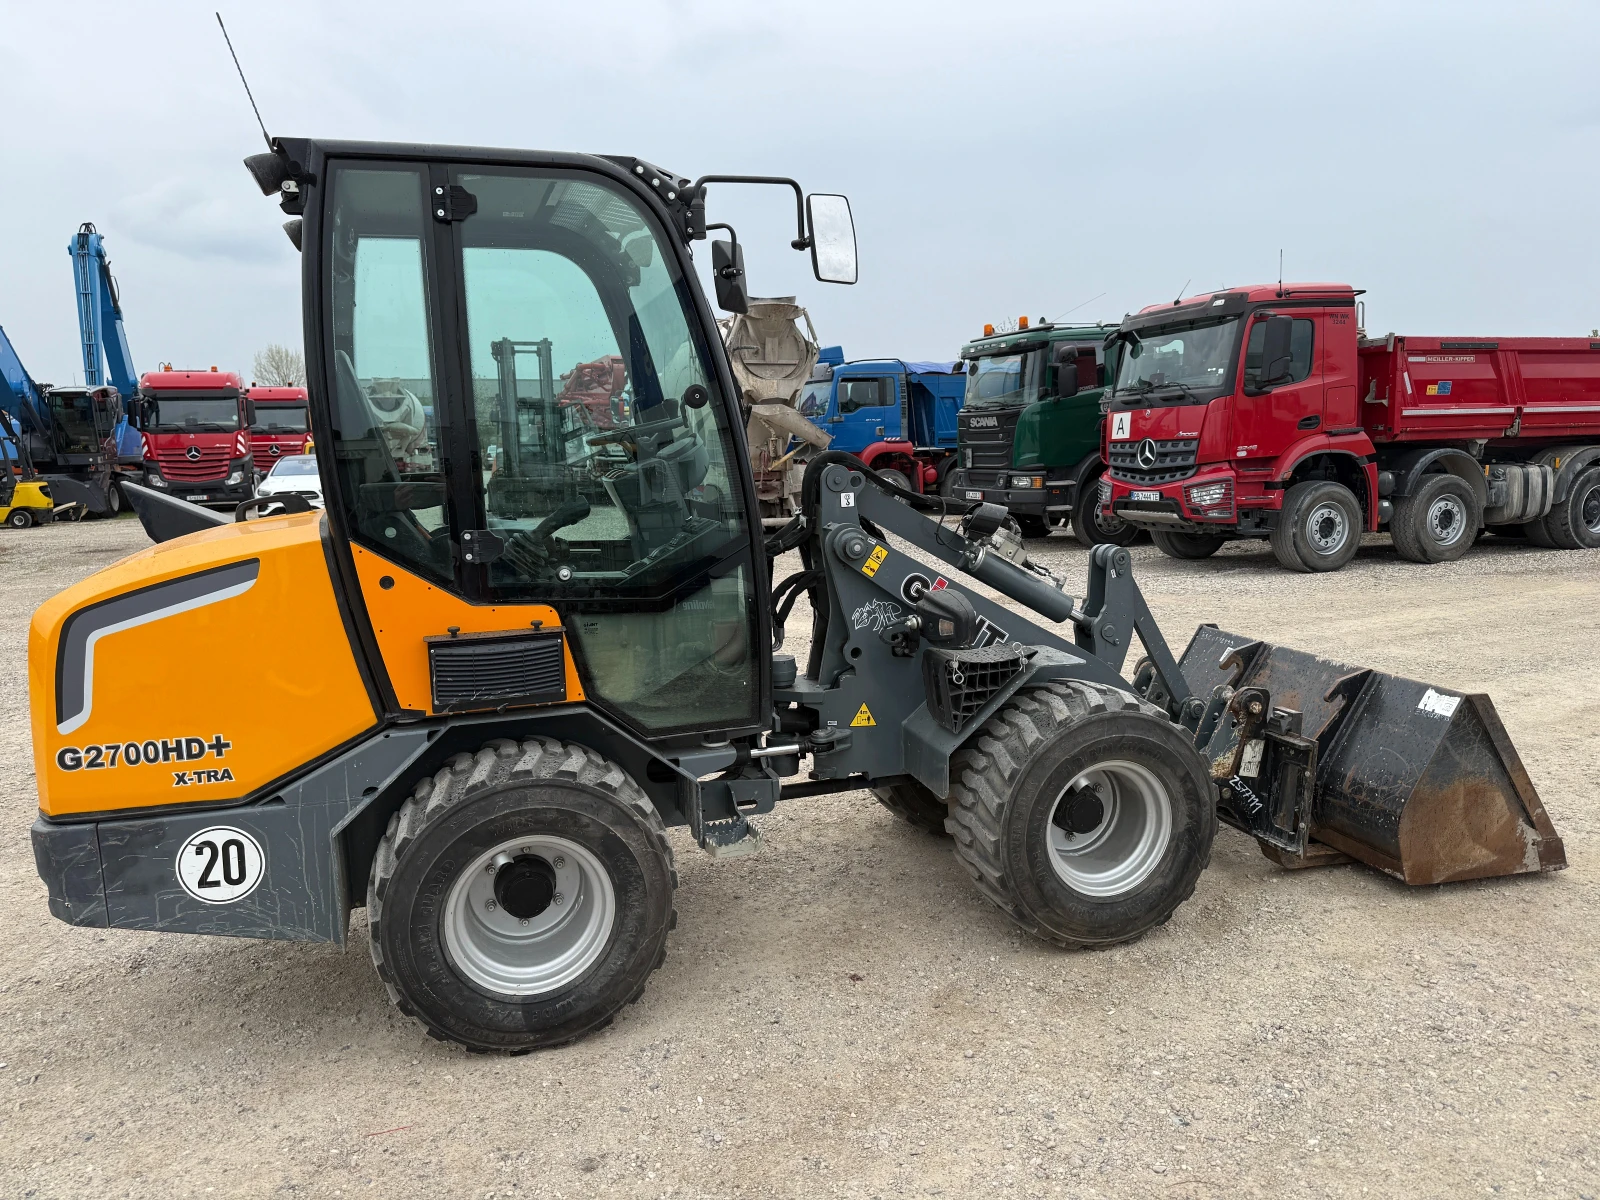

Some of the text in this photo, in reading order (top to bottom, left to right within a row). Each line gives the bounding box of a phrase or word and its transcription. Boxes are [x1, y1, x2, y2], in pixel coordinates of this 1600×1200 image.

[969, 416, 998, 428] SCANIA
[1116, 417, 1125, 436] A
[56, 734, 231, 771] G2700HD+
[172, 768, 235, 786] X-TRA
[194, 837, 247, 890] 20
[419, 858, 457, 917] GUARD
